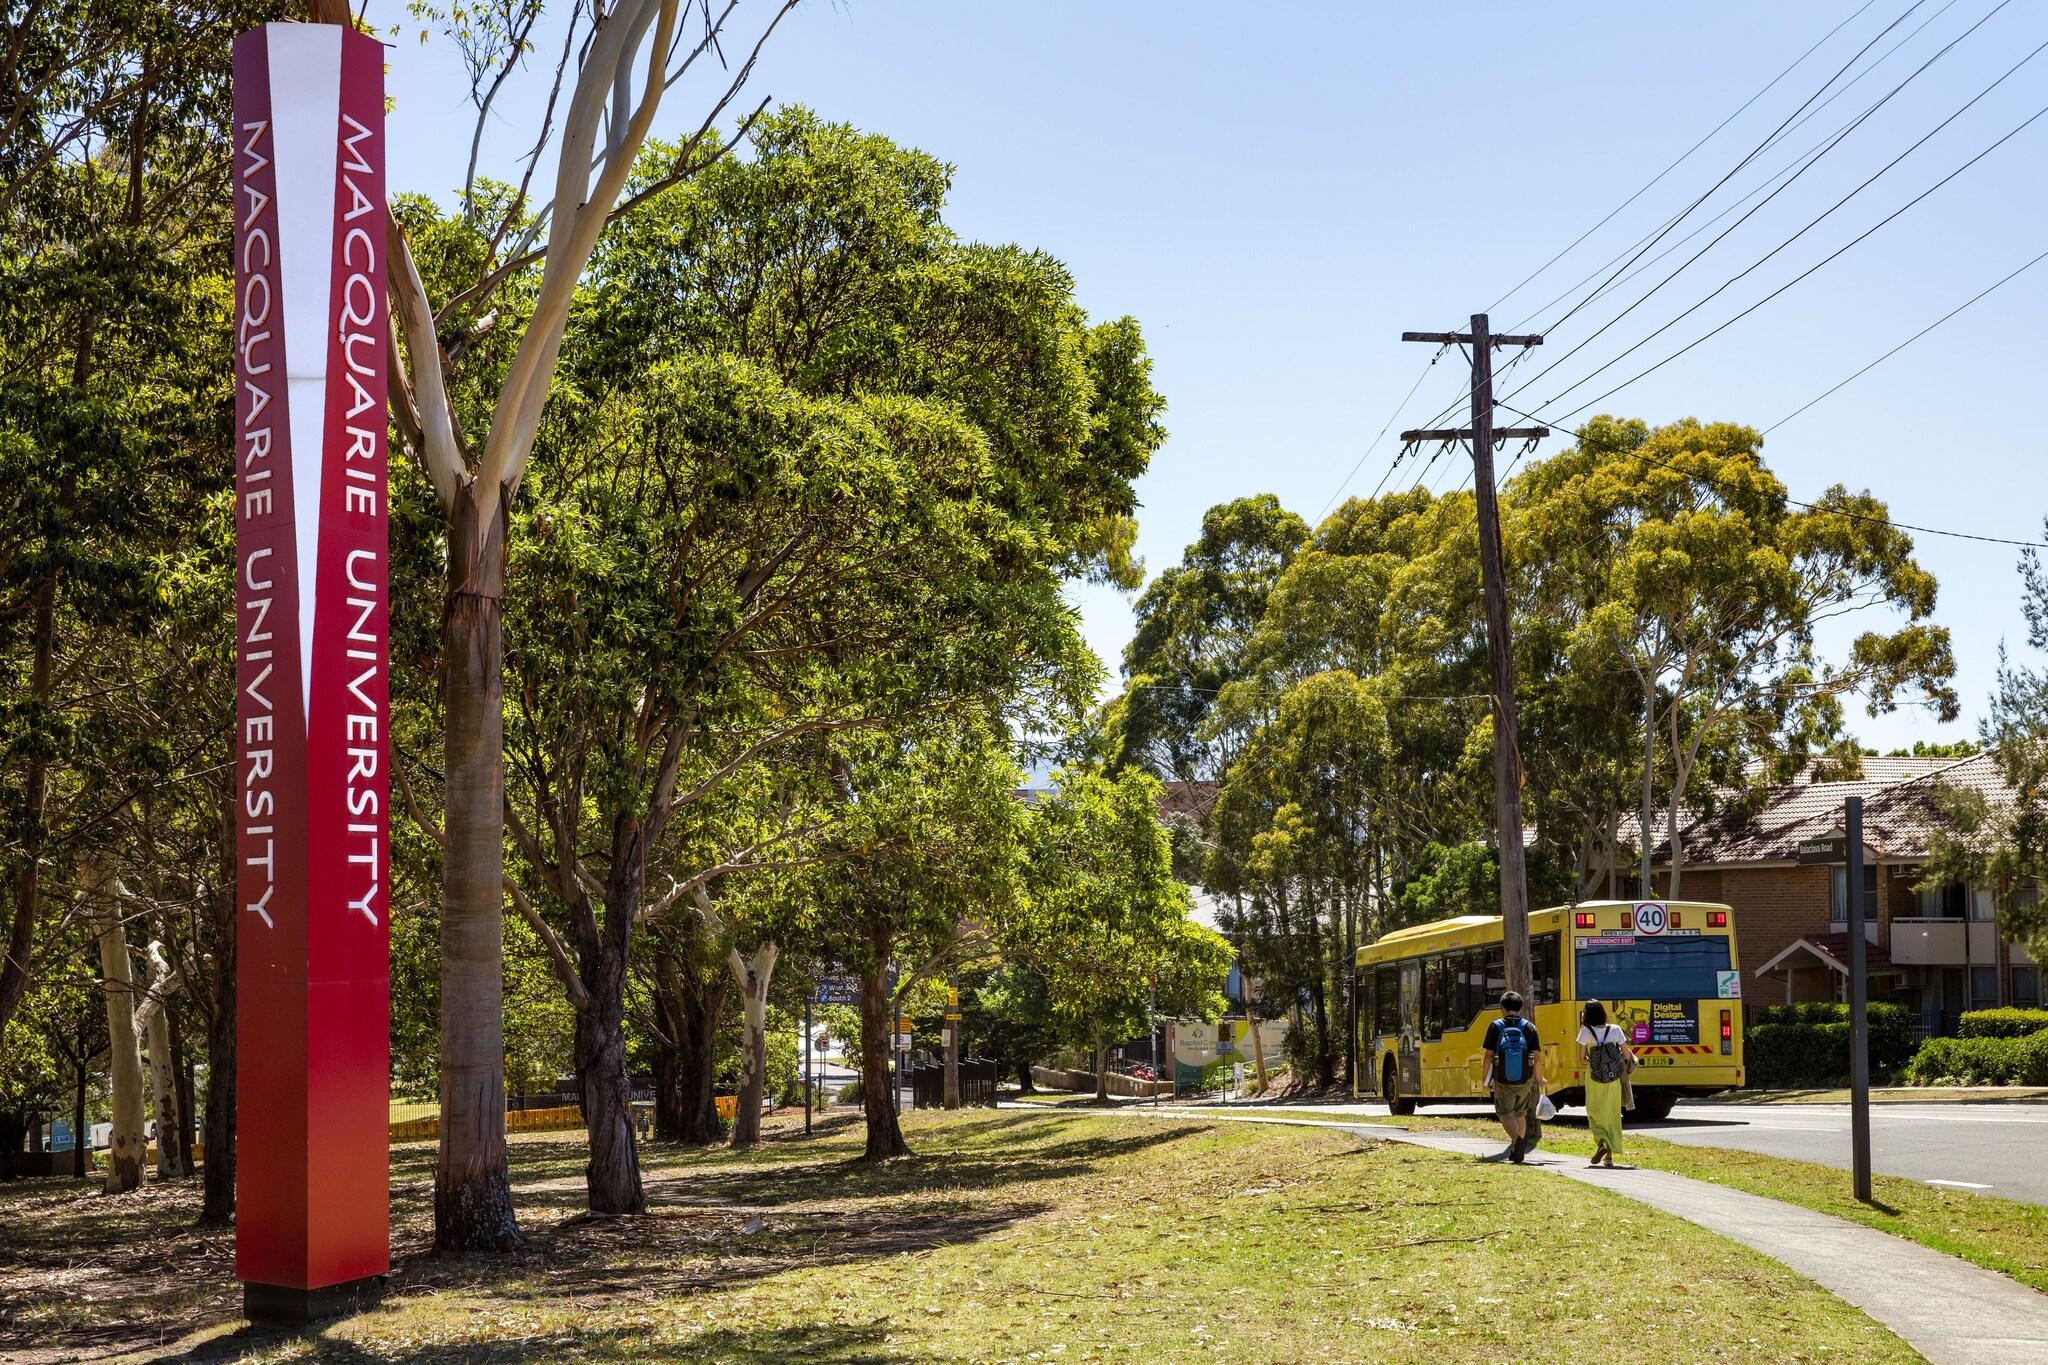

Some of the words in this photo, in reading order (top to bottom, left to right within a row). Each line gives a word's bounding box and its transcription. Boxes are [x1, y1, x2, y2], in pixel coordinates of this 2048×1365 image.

[239, 120, 272, 519] MACQUARIE
[338, 113, 377, 518] MACQUARIE
[246, 548, 273, 928] UNIVERSITY
[346, 549, 378, 927] UNIVERSITY
[1639, 910, 1663, 927] 40
[1820, 842, 1832, 851] Road
[1653, 1003, 1681, 1012] Digital
[1653, 1011, 1685, 1019] Design.
